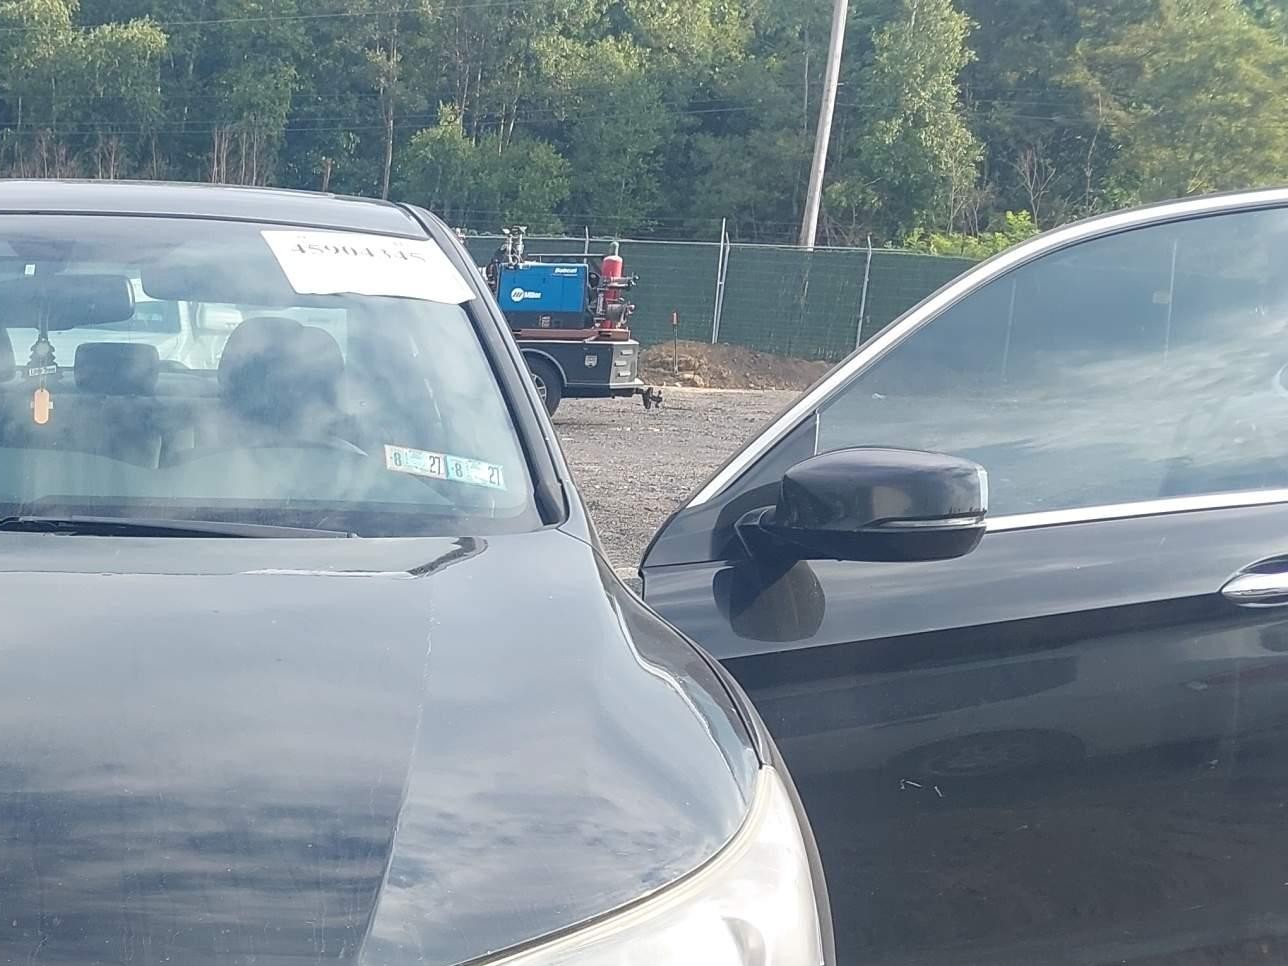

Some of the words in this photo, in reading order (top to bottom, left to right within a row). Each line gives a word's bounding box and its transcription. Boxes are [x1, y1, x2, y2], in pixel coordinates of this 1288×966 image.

[393, 452, 402, 467] 8
[429, 455, 441, 475] 27
[454, 462, 464, 478] 8
